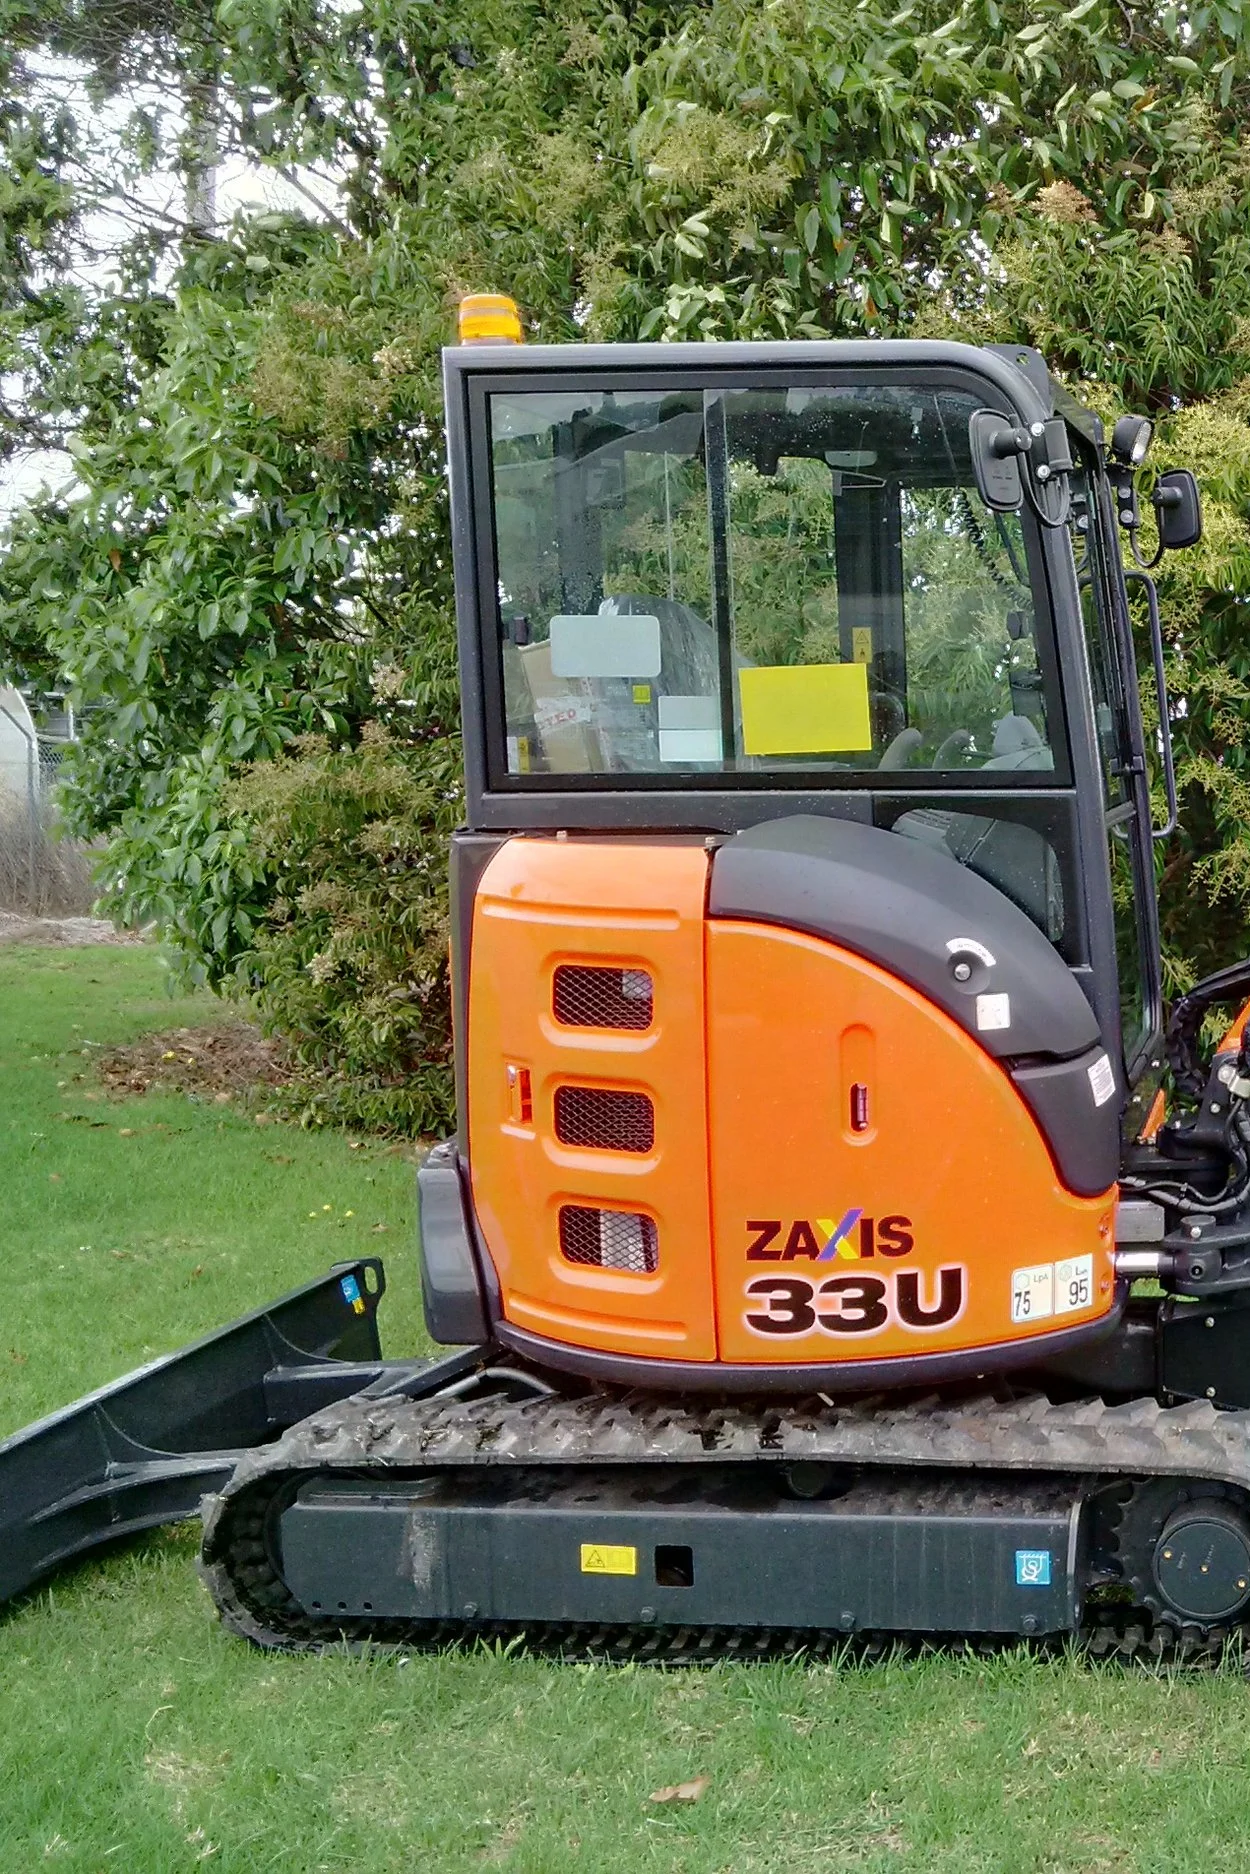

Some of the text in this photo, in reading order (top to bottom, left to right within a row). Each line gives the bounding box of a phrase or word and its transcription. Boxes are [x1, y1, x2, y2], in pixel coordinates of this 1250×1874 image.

[745, 1207, 914, 1261] ZAXIS
[745, 1266, 962, 1334] 33U
[1014, 1290, 1031, 1317] 75
[1069, 1277, 1089, 1306] 95
